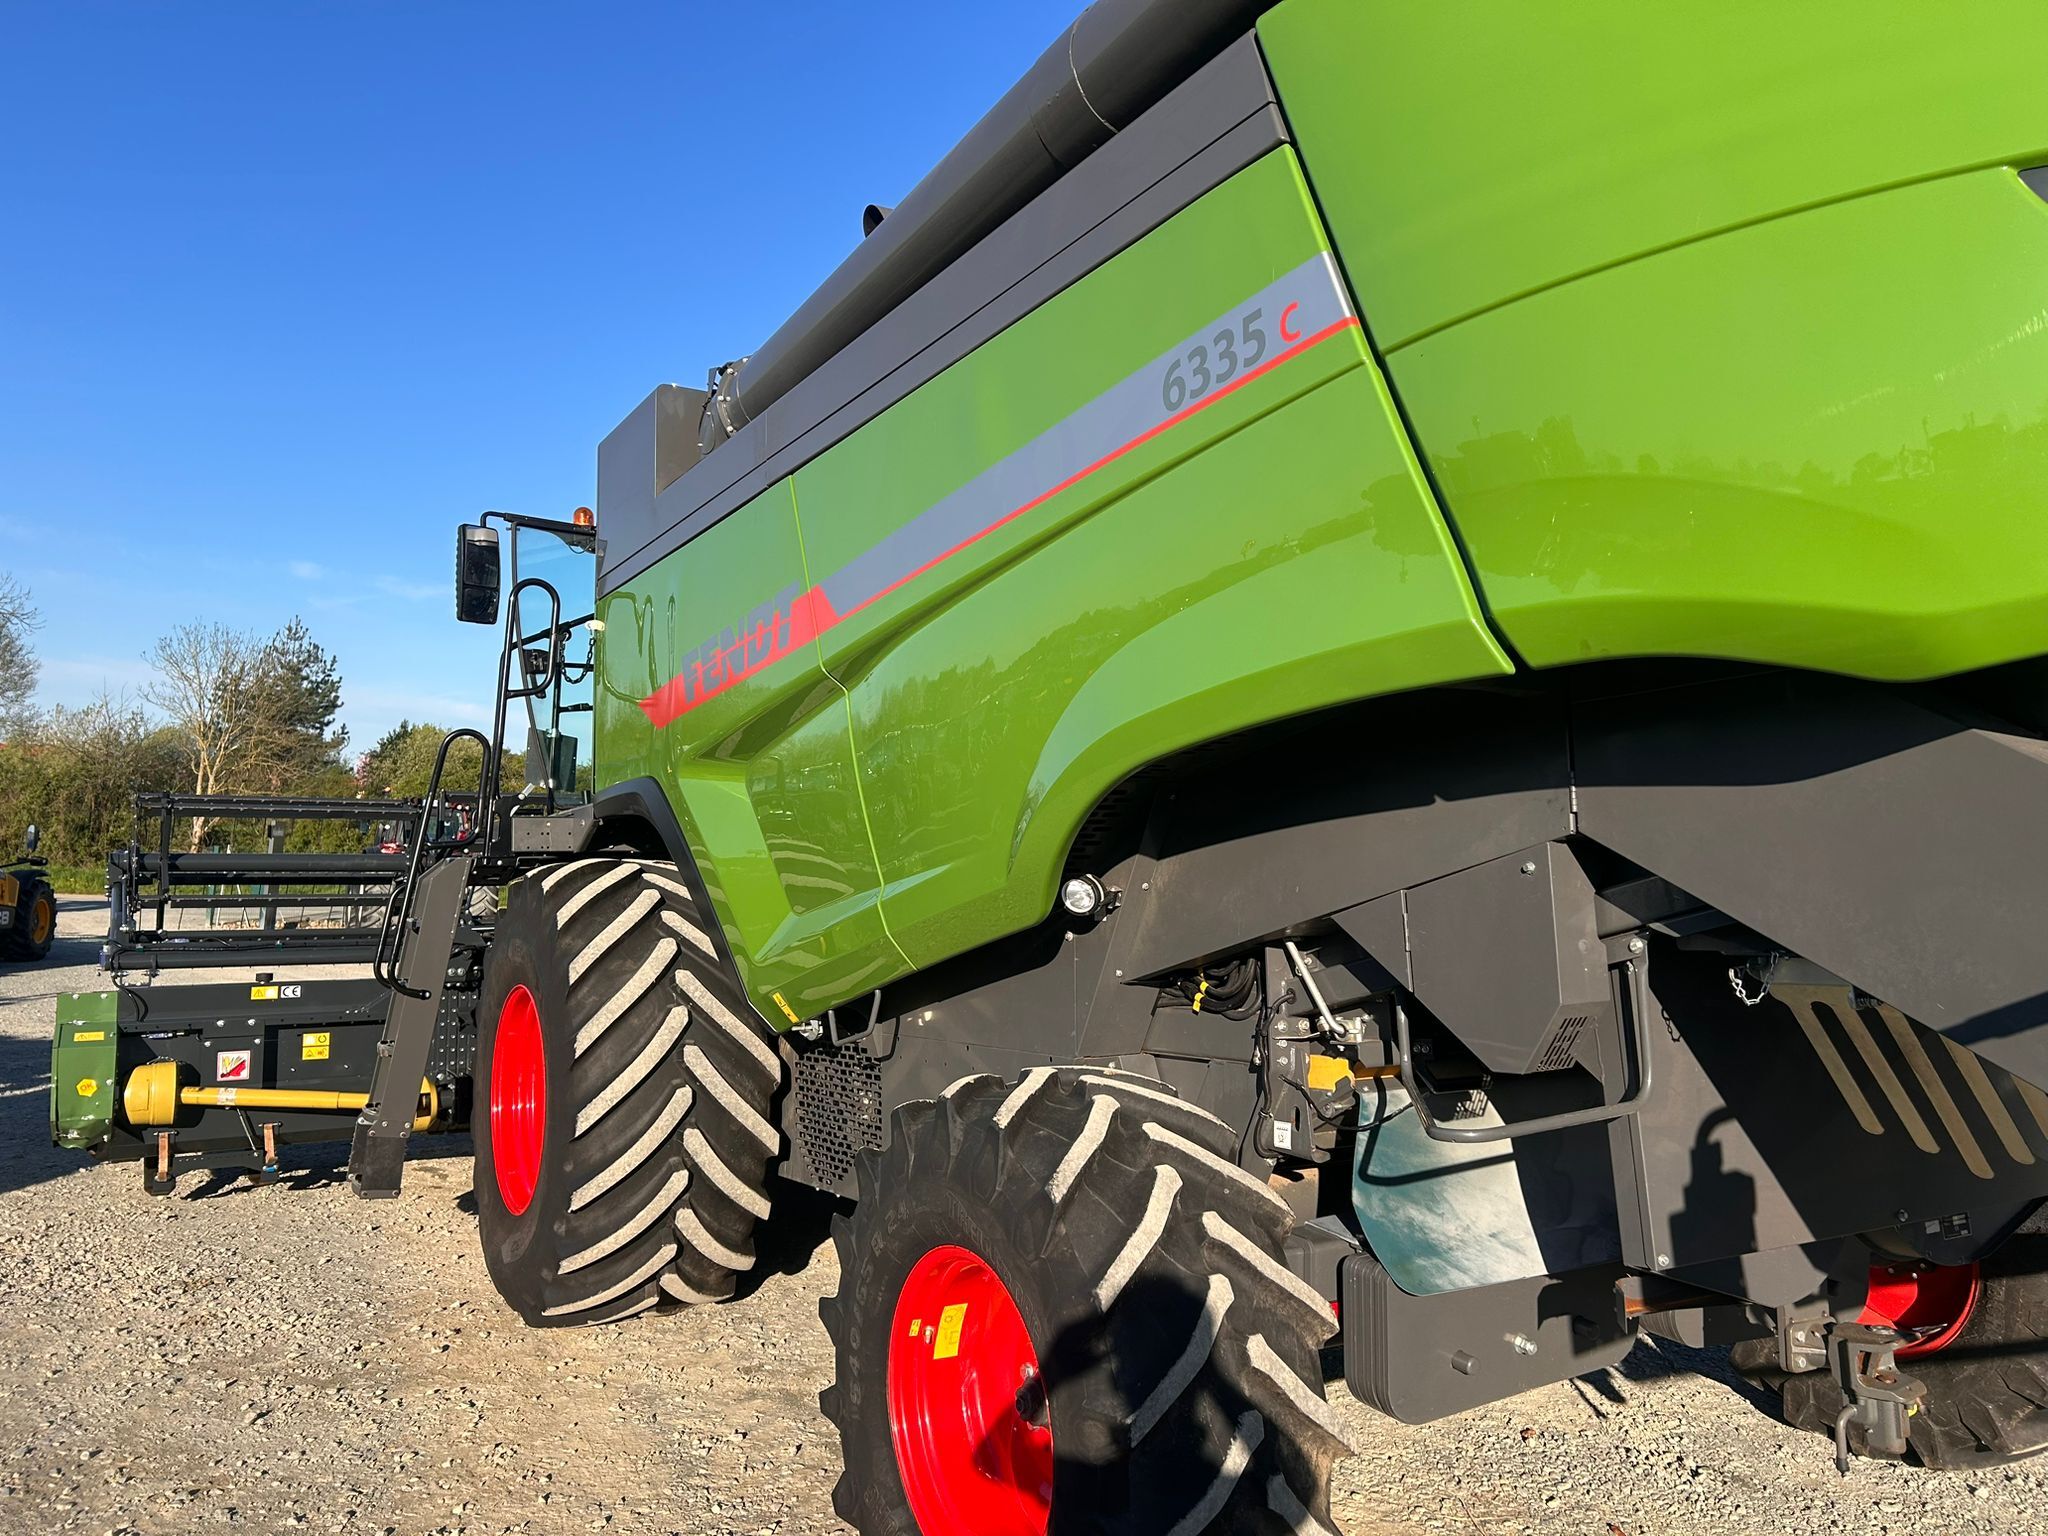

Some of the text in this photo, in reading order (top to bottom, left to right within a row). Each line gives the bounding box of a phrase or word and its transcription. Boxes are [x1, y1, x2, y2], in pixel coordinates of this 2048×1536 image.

[1162, 307, 1266, 412] 6335
[680, 578, 800, 704] FENDT
[282, 986, 299, 997] CE
